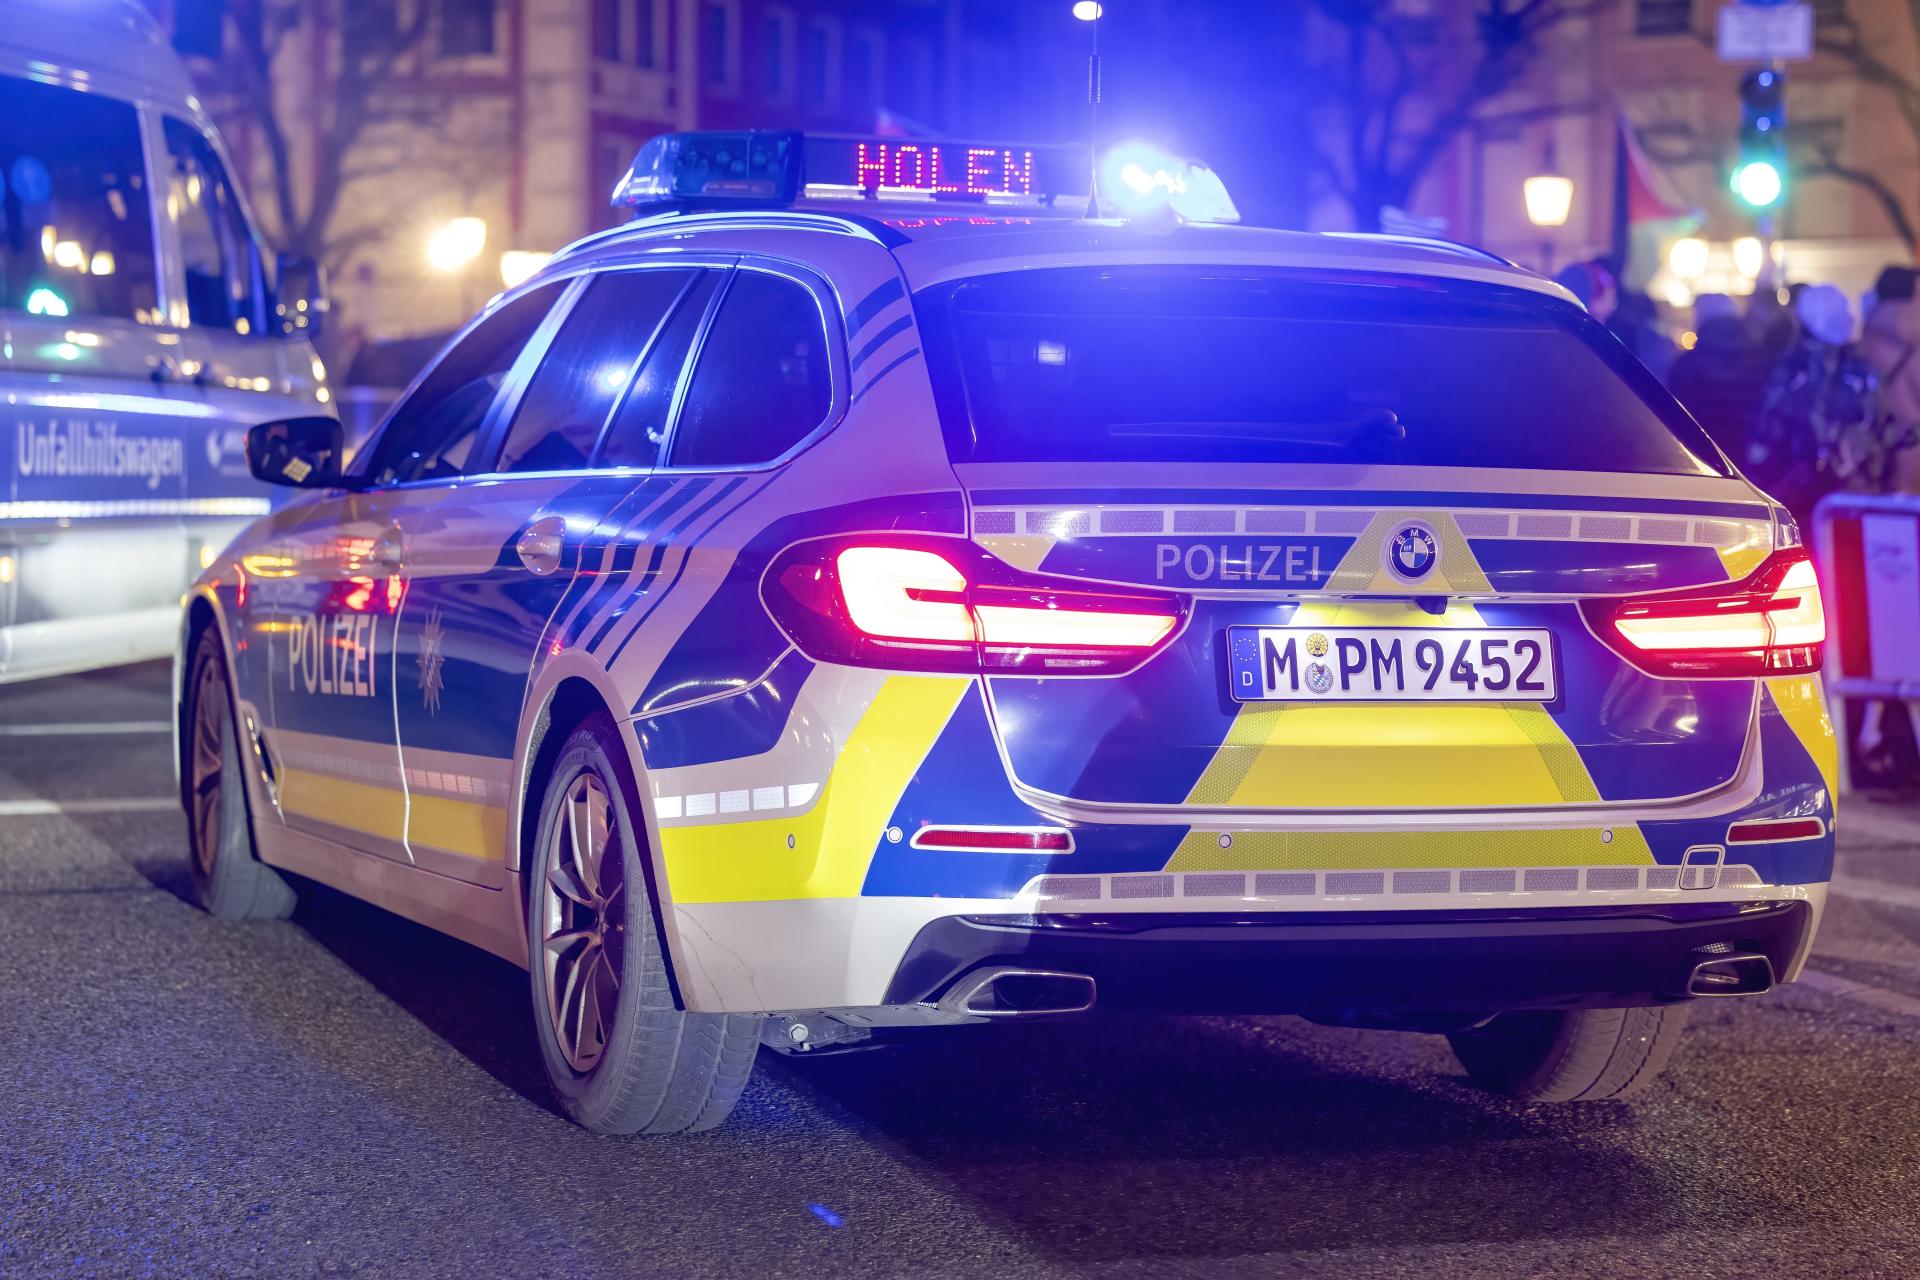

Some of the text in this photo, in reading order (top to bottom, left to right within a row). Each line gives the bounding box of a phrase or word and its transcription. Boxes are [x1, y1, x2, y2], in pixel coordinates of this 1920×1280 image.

[858, 143, 1032, 196] HOLEN
[18, 419, 184, 490] Unfallhilfswagen
[1155, 543, 1320, 582] POLIZEI
[1395, 528, 1434, 545] BMW
[289, 613, 379, 697] POLIZEI
[1242, 670, 1254, 687] D
[1264, 637, 1545, 692] M PM 9452
